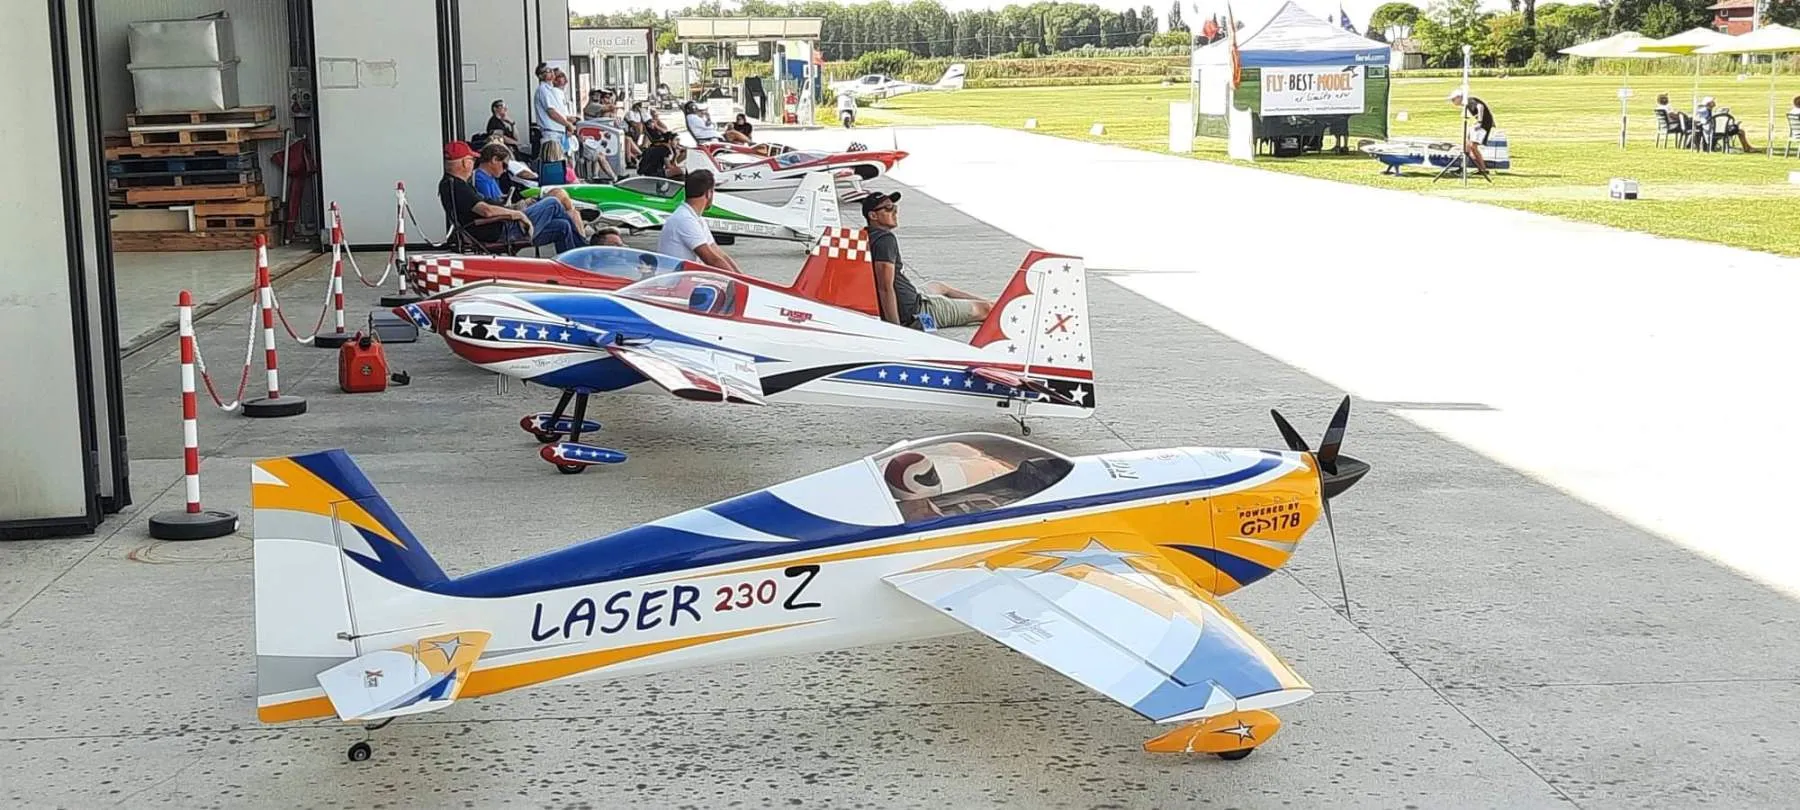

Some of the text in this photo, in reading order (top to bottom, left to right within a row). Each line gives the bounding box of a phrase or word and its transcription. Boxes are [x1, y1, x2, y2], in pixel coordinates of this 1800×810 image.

[1289, 73, 1314, 91] BEST
[1316, 72, 1353, 91] MODEL
[780, 307, 813, 321] LASER
[1239, 502, 1300, 519] POWERED BY
[1240, 512, 1301, 536] GP178
[531, 584, 702, 642] LASER
